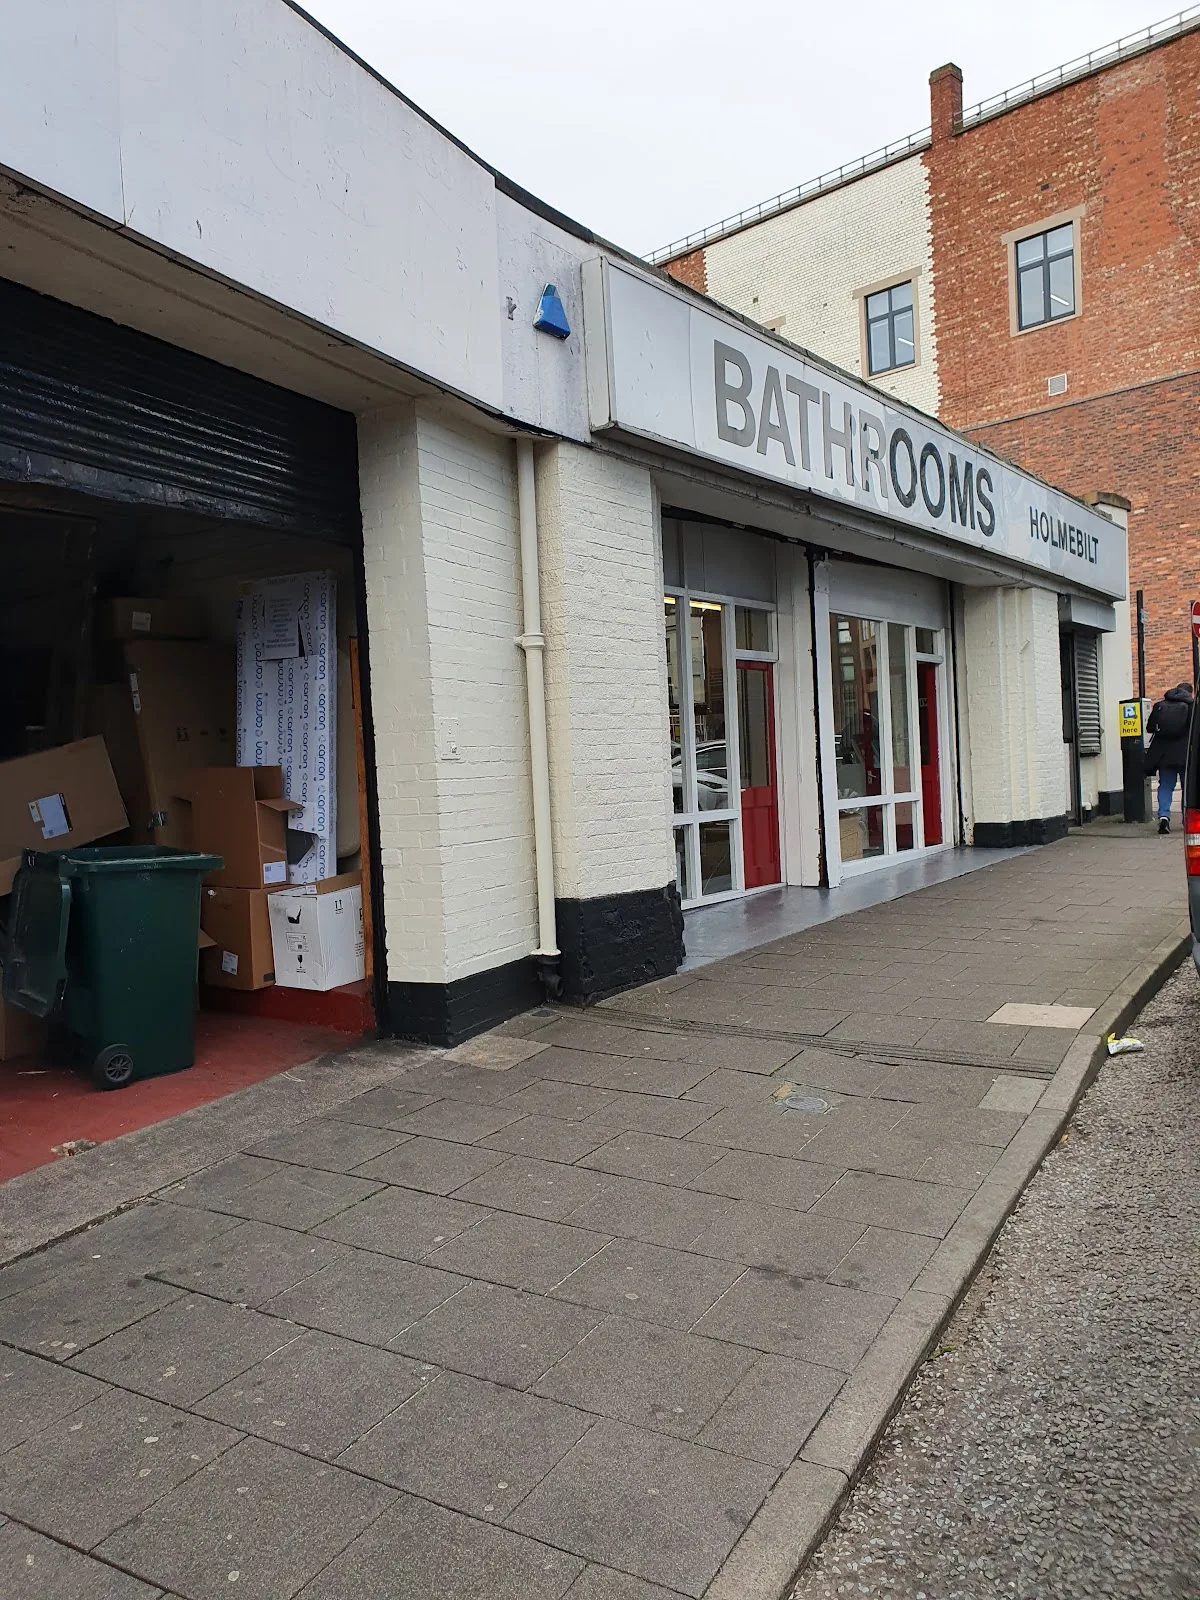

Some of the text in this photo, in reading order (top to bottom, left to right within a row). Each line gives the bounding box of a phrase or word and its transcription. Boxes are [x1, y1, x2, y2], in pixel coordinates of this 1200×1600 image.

[713, 339, 995, 537] BATHROOMS
[1028, 506, 1099, 565] HOLMEBILT
[318, 693, 326, 730] carron
[318, 744, 326, 781] carron
[317, 794, 326, 832] carron
